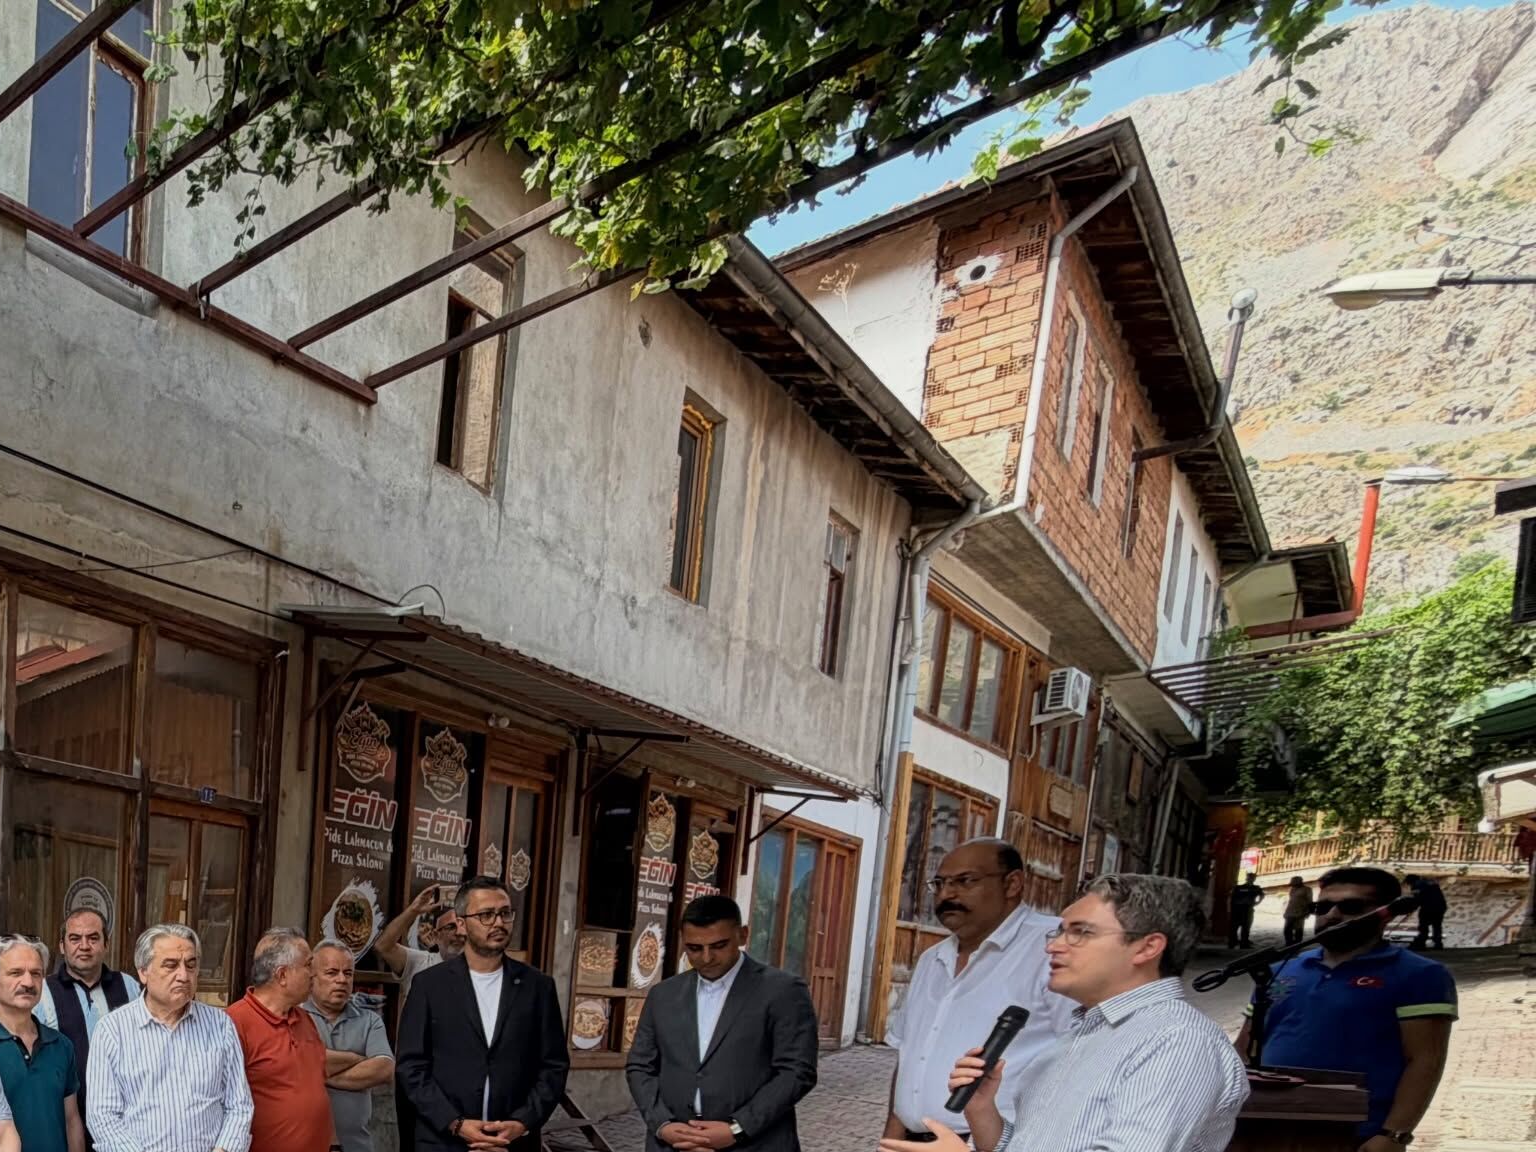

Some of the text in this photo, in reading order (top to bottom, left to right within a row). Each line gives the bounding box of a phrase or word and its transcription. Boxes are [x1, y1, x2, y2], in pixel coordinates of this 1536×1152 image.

[325, 787, 398, 831] EĞİN
[413, 807, 472, 848] EĞİN
[386, 838, 393, 853] &
